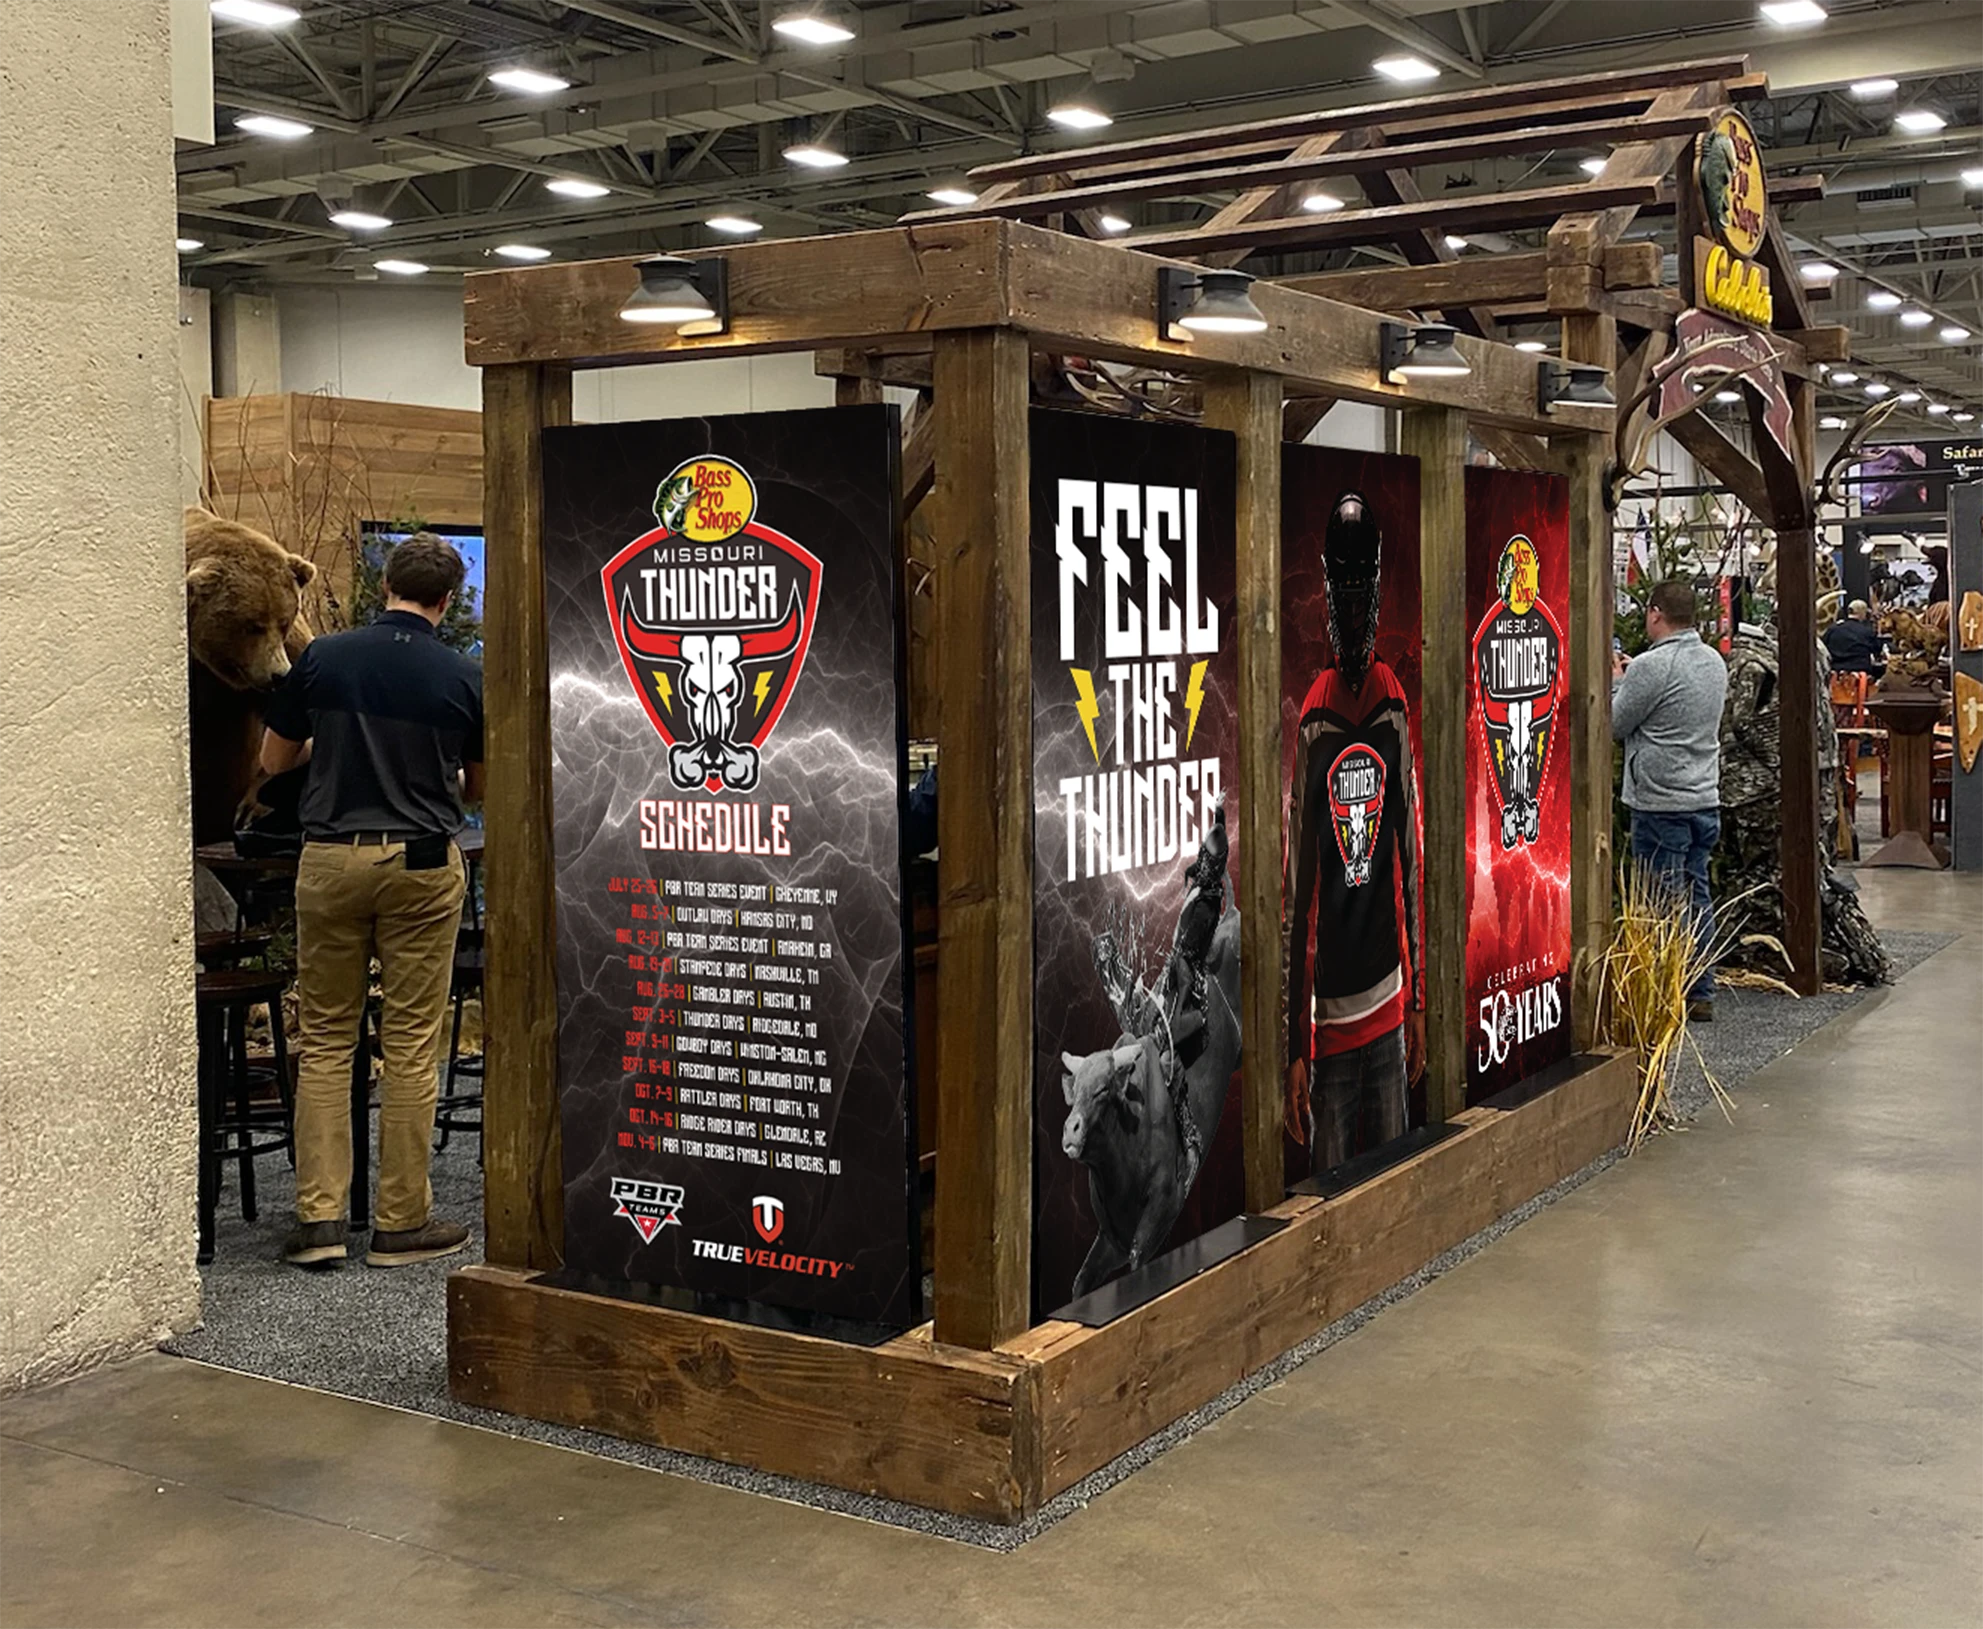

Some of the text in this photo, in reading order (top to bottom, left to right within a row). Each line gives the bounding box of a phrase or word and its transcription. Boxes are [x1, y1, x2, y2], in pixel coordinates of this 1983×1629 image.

[694, 465, 731, 487] Bass
[695, 487, 724, 508] Pro
[695, 506, 742, 534] Shops
[654, 545, 763, 563] MISSOURI
[1055, 478, 1219, 660] FEEL
[640, 565, 777, 621] THUNDER
[1490, 636, 1548, 690] THUNDER
[1108, 661, 1177, 765] THE
[640, 800, 791, 856] SCHEDULE
[1059, 757, 1221, 882] THUNDER
[1478, 989, 1510, 1073] 50
[1515, 976, 1562, 1044] YEARS
[613, 1181, 683, 1204] PBR
[629, 1203, 666, 1216] TEAMS
